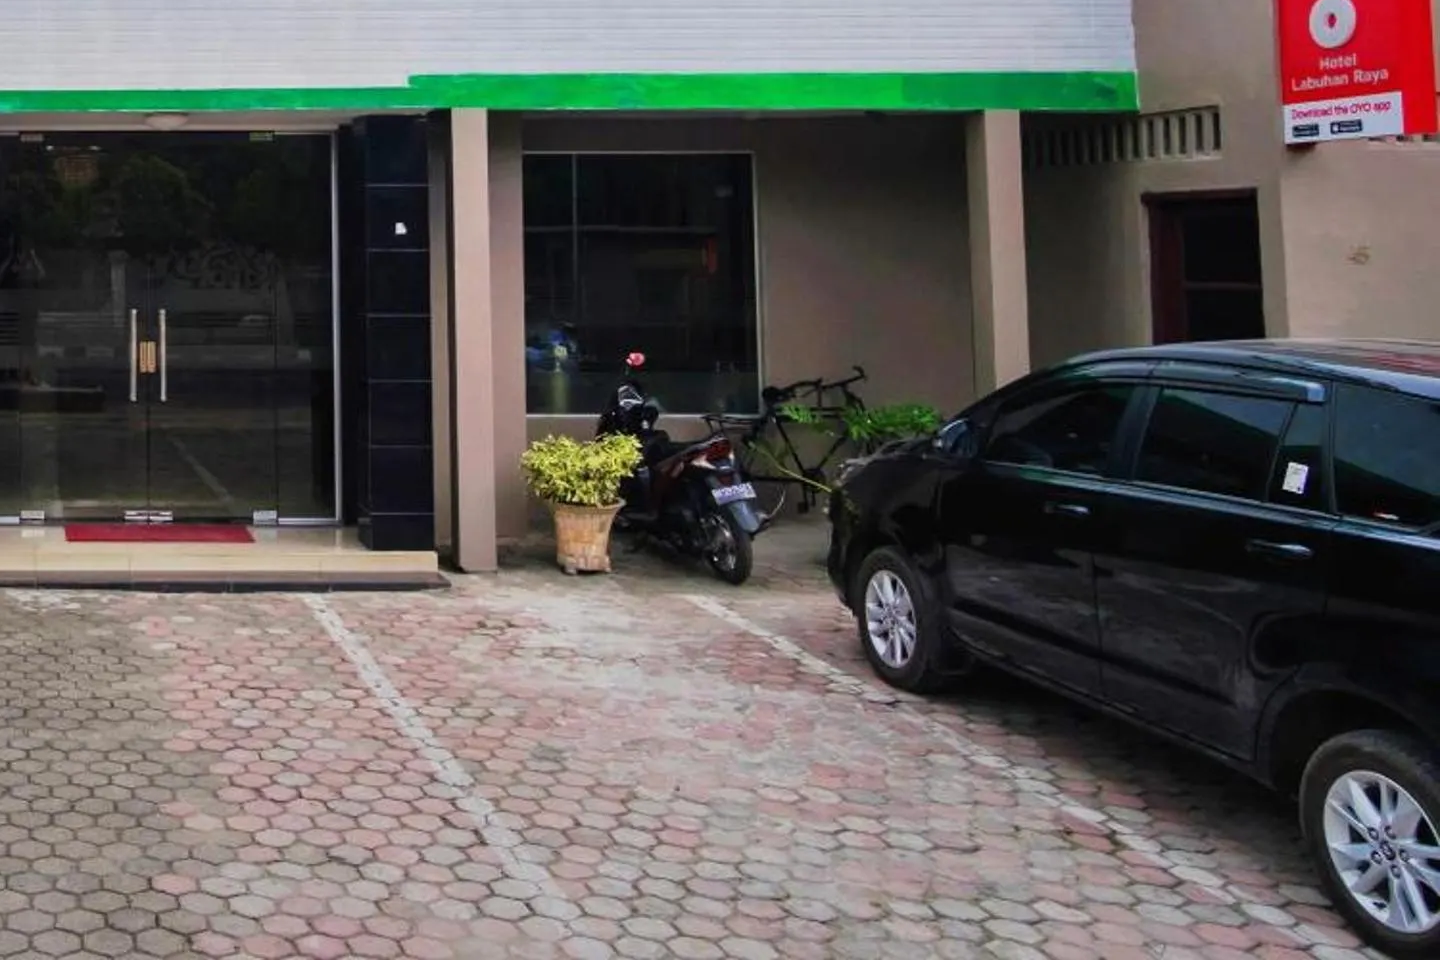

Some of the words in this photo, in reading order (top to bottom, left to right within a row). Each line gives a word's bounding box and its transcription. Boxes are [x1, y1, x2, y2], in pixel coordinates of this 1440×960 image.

[1319, 53, 1358, 71] Hotel
[1291, 73, 1349, 92] Labuhan
[1353, 68, 1389, 86] Raya
[1350, 102, 1372, 114] OYO
